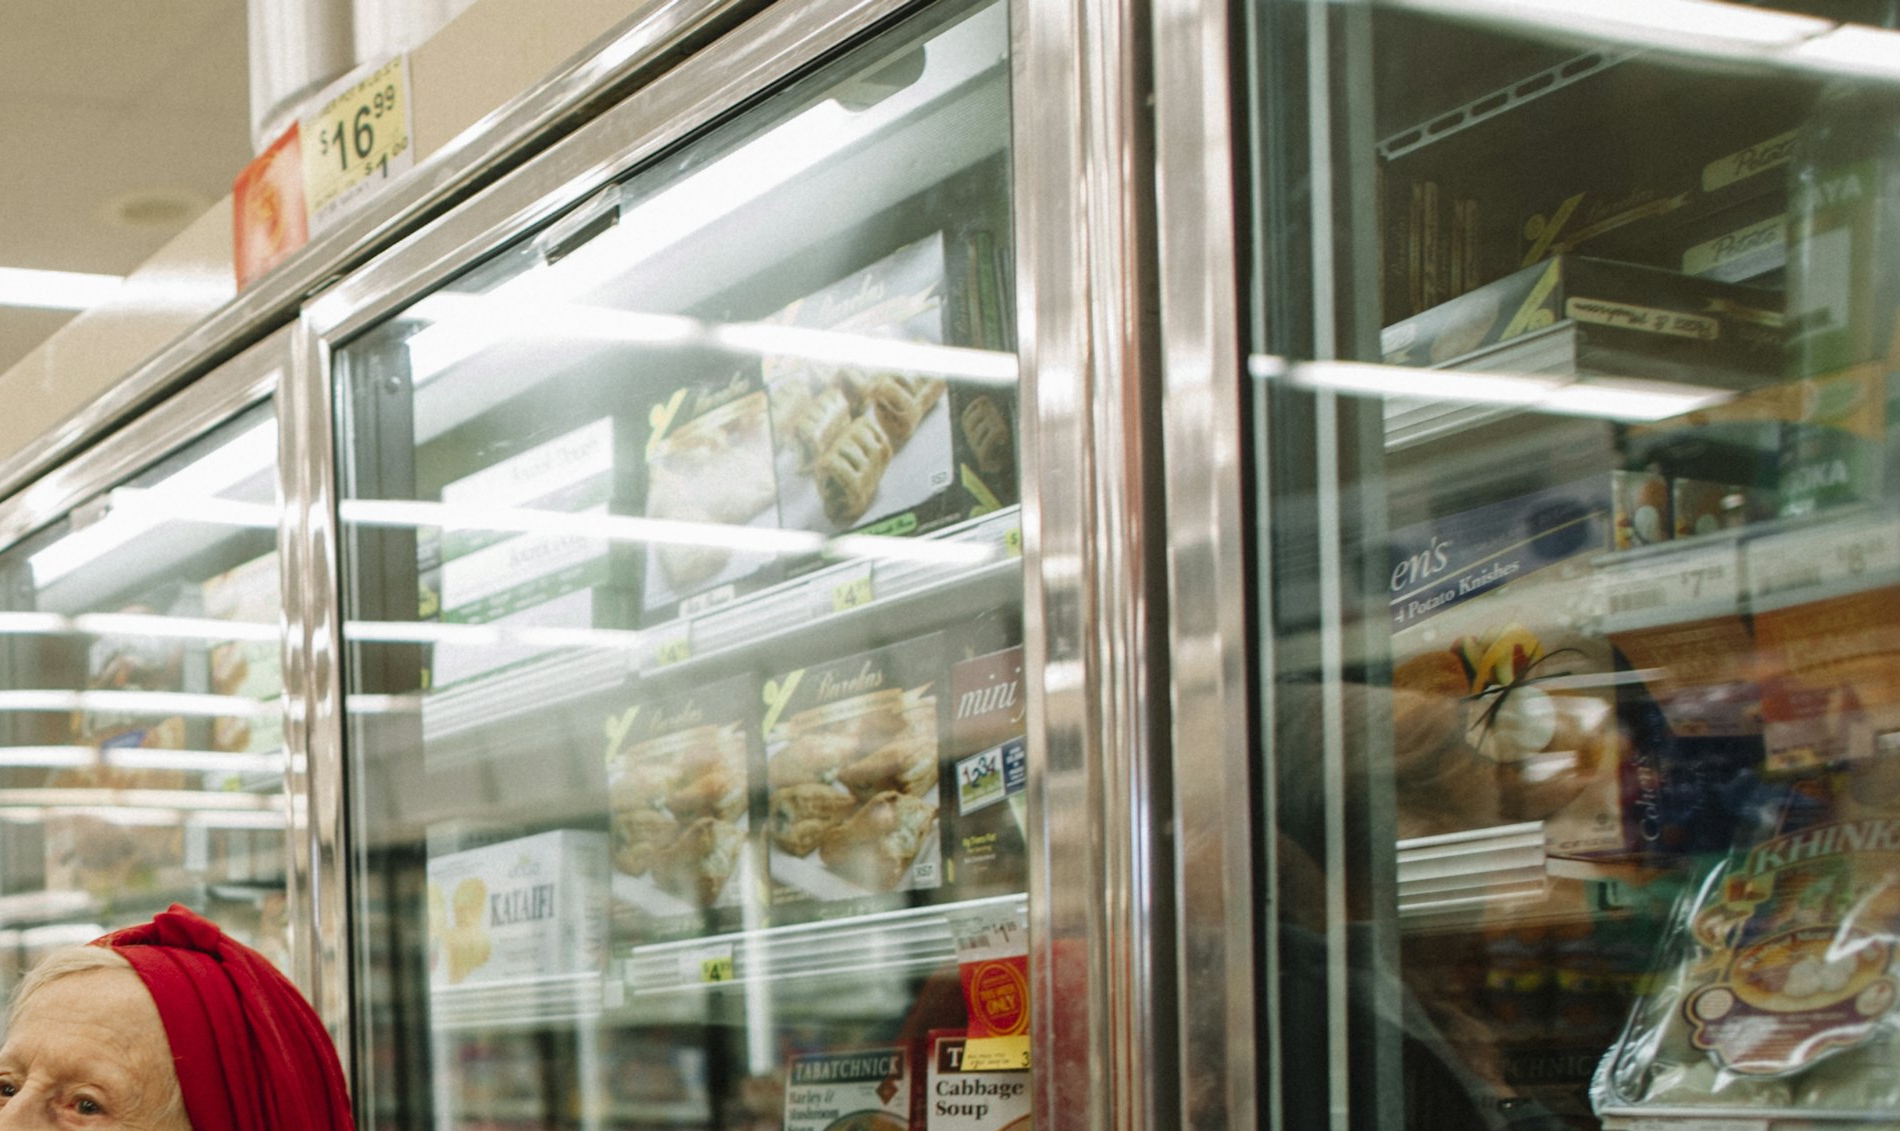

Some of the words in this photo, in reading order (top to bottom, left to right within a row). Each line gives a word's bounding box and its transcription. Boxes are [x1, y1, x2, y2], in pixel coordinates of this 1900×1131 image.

[1406, 586, 1457, 621] Potato
[1458, 559, 1520, 596] Knishes
[956, 673, 1018, 721] mini
[794, 1056, 901, 1082] TABATCHNICK
[935, 1079, 1024, 1100] Cabbage
[935, 1101, 989, 1120] Soup
